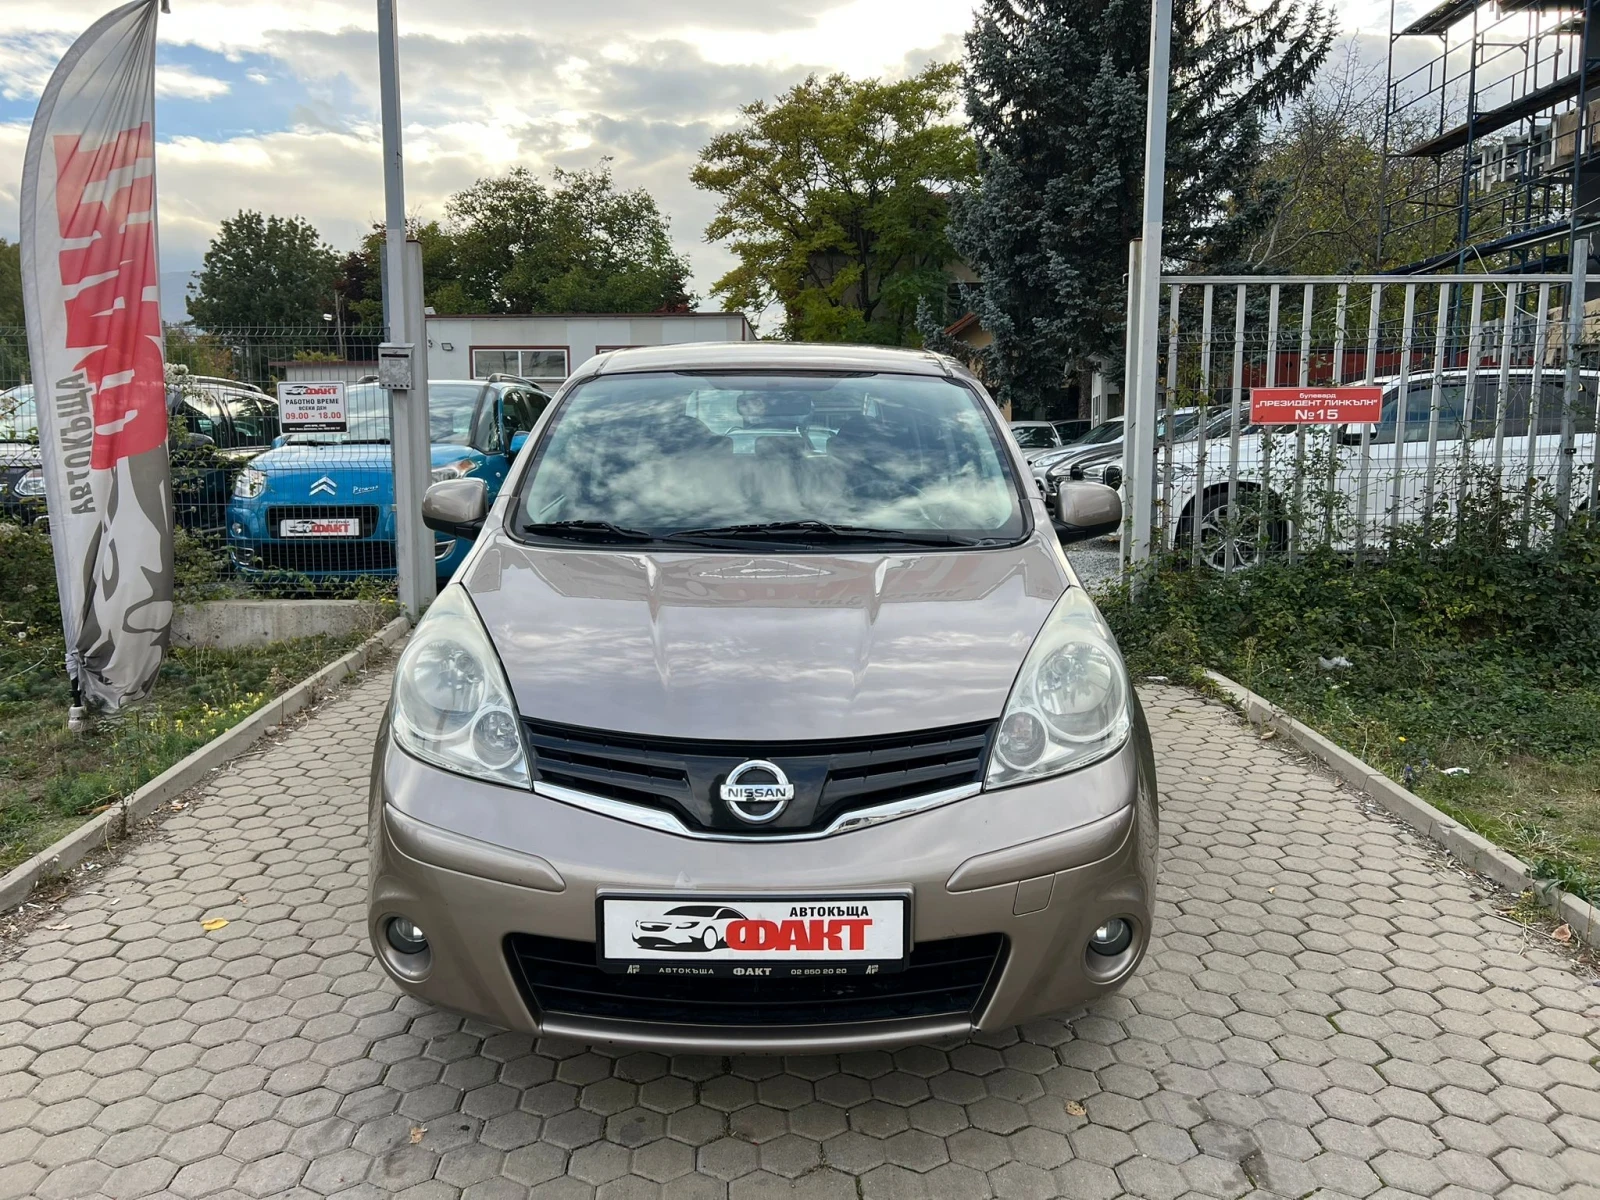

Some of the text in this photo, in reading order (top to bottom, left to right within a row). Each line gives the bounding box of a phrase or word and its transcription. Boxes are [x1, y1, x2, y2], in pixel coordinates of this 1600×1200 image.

[285, 412, 309, 420] 09.00
[318, 411, 342, 419] 18.00
[55, 372, 97, 515] АВТОКЪЩА
[727, 788, 787, 798] NISSAN
[789, 905, 870, 918] АВТОКЪЩА
[725, 918, 873, 951] ФАКТ
[732, 967, 773, 976] ФАКТ
